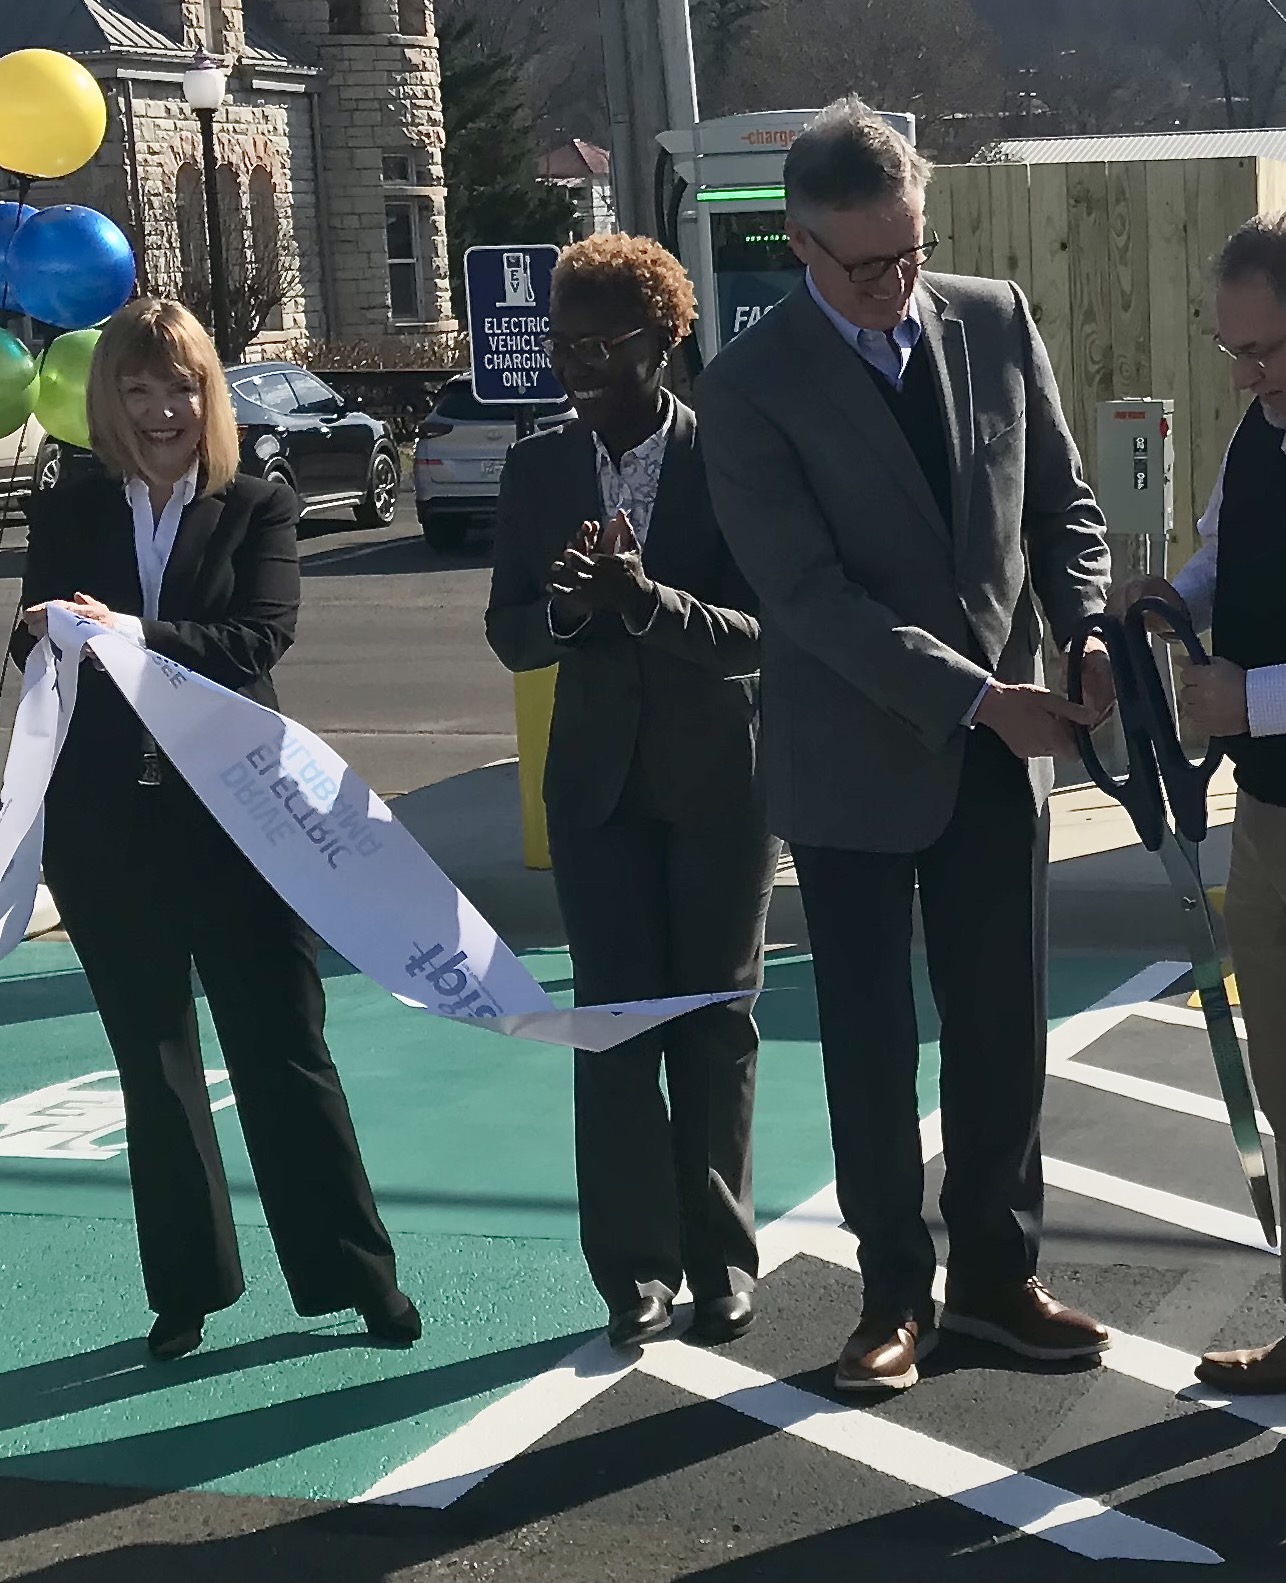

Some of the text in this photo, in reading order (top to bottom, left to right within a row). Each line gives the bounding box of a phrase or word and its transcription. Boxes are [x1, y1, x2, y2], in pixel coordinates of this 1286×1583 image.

[745, 128, 798, 147] charge
[509, 269, 521, 294] EV
[484, 316, 551, 334] ELECTRIC
[733, 305, 774, 333] FA
[488, 334, 542, 352] VEHICL
[502, 371, 540, 387] ONLY
